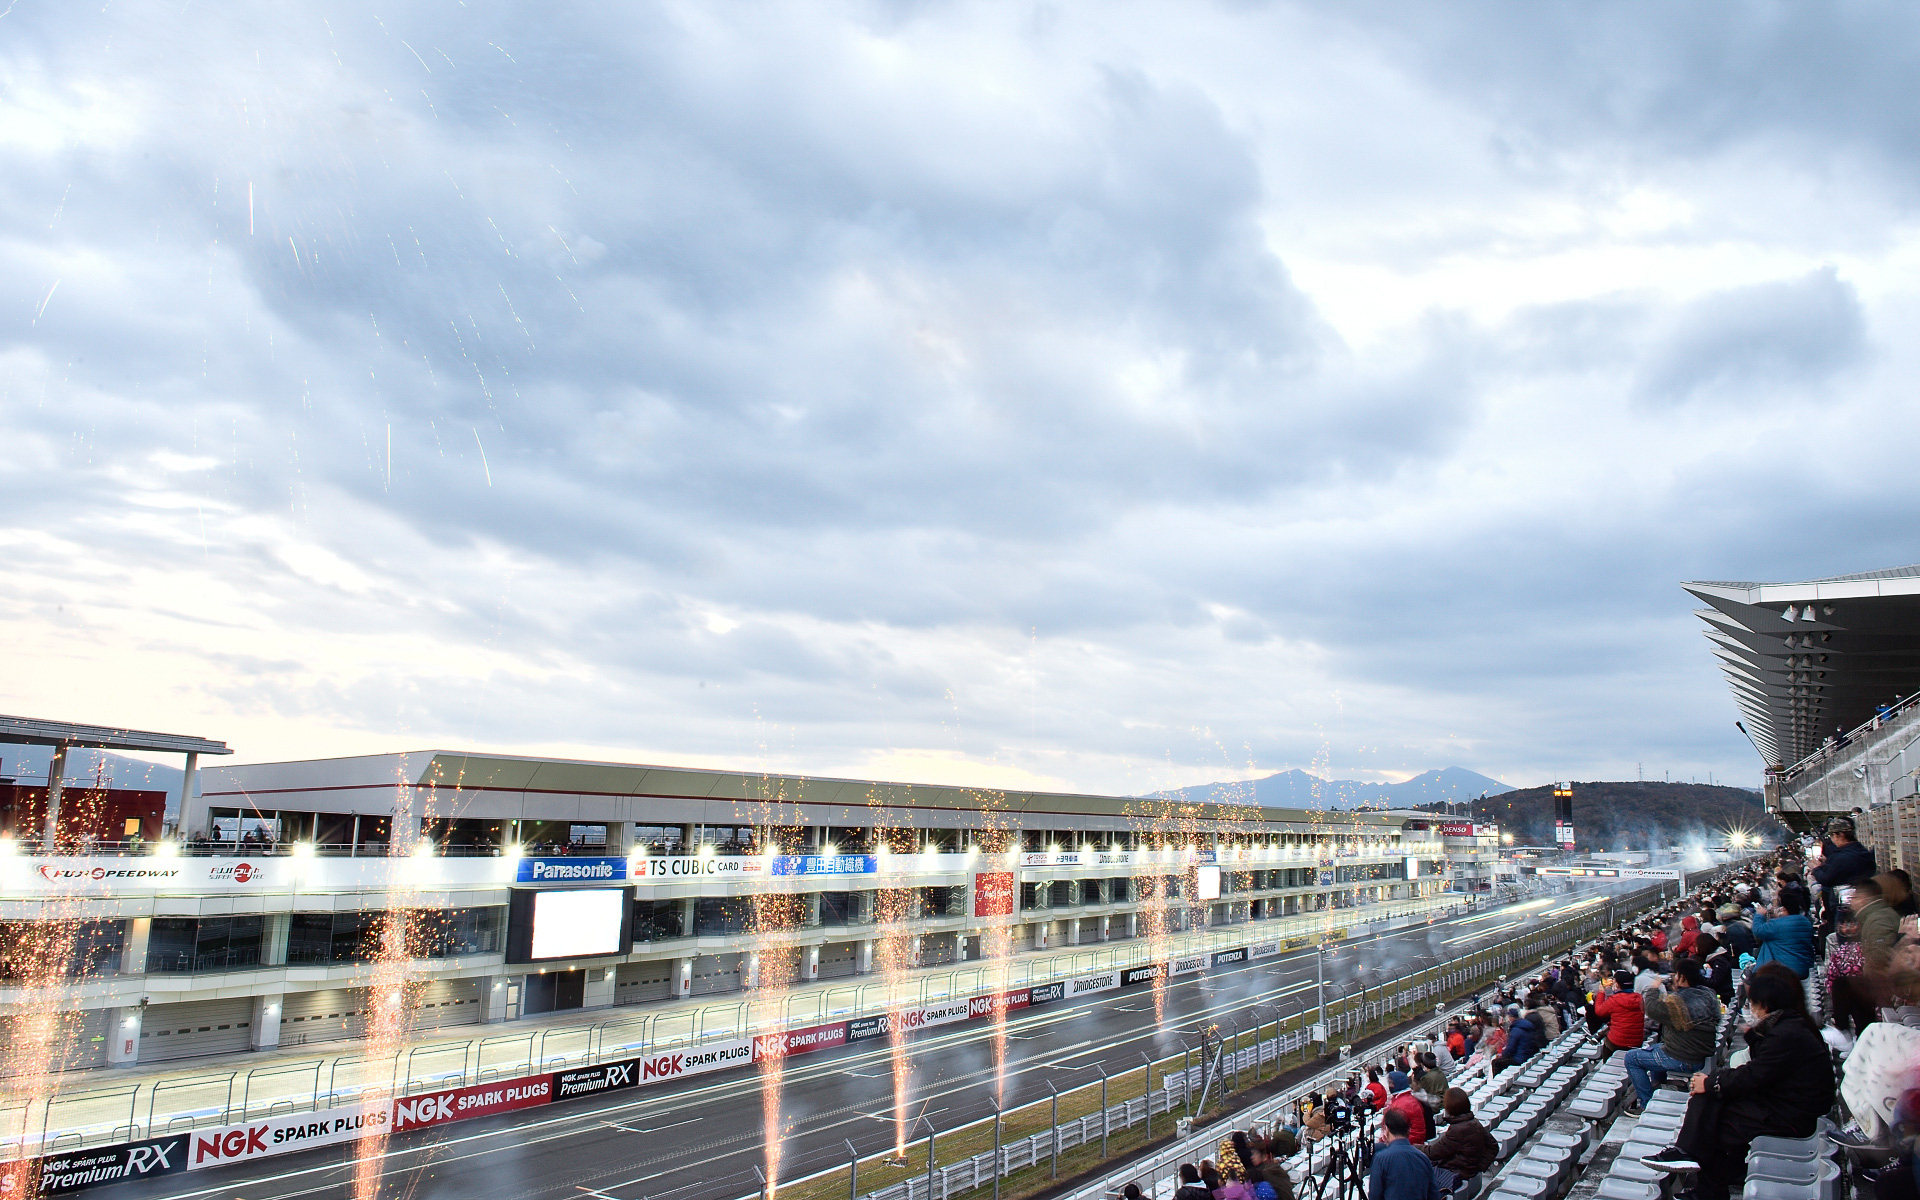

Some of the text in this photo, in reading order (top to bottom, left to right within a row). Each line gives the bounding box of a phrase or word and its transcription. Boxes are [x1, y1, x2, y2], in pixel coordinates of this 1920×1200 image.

[53, 867, 179, 880] FUJI SPEEDWAY
[532, 861, 613, 879] Panasonic
[650, 859, 667, 876] TS
[671, 859, 715, 875] CUBIC
[717, 861, 739, 871] CARD
[805, 856, 865, 874] 豊田自動織機
[1175, 956, 1206, 972] BRIDGESTONE
[1217, 950, 1243, 963] POTENZA
[1050, 984, 1063, 999] RX
[1072, 974, 1114, 993] BRIDGESTONE
[970, 995, 992, 1016] NGK
[1011, 993, 1029, 1005] PLUGS
[901, 1004, 968, 1030] NGK SPARK PLUGS
[850, 1026, 878, 1040] Premium
[753, 1027, 844, 1059] NGK SPARK PLUGS
[643, 1045, 750, 1081] NGK SPARK PLUGS
[560, 1062, 634, 1096] Premium RX
[561, 1073, 577, 1083] NGK
[396, 1082, 549, 1127] NGK SPARK PLUGS
[195, 1110, 387, 1164] NGK SPARK PLUGS
[39, 1164, 124, 1191] Premium
[122, 1140, 179, 1177] RX
[43, 1154, 117, 1174] NGK SPARK PLUG
